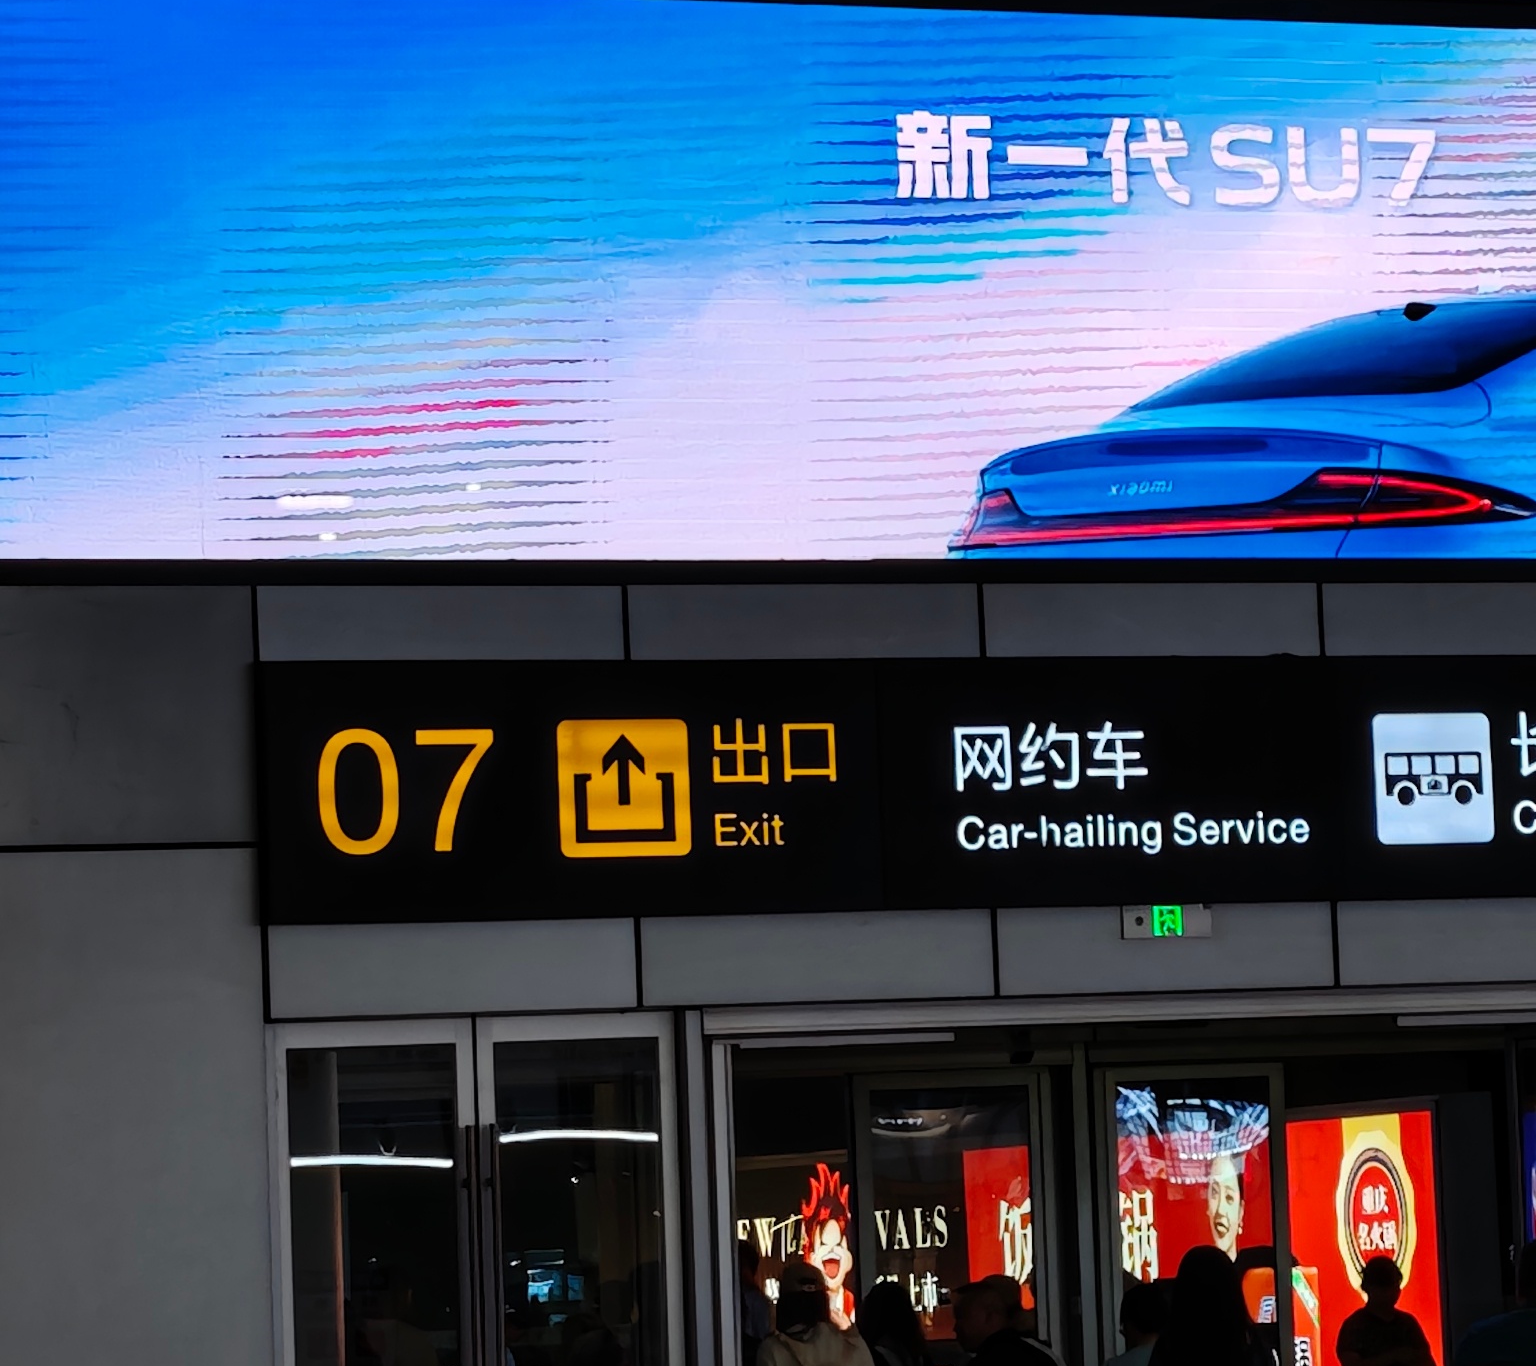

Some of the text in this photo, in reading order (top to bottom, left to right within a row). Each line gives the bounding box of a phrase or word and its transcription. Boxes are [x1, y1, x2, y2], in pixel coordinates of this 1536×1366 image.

[712, 718, 837, 785] 出口
[953, 720, 1149, 793] 网约车
[317, 728, 494, 856] 07
[714, 812, 785, 847] Exit
[956, 810, 1311, 855] Car-hailing Service
